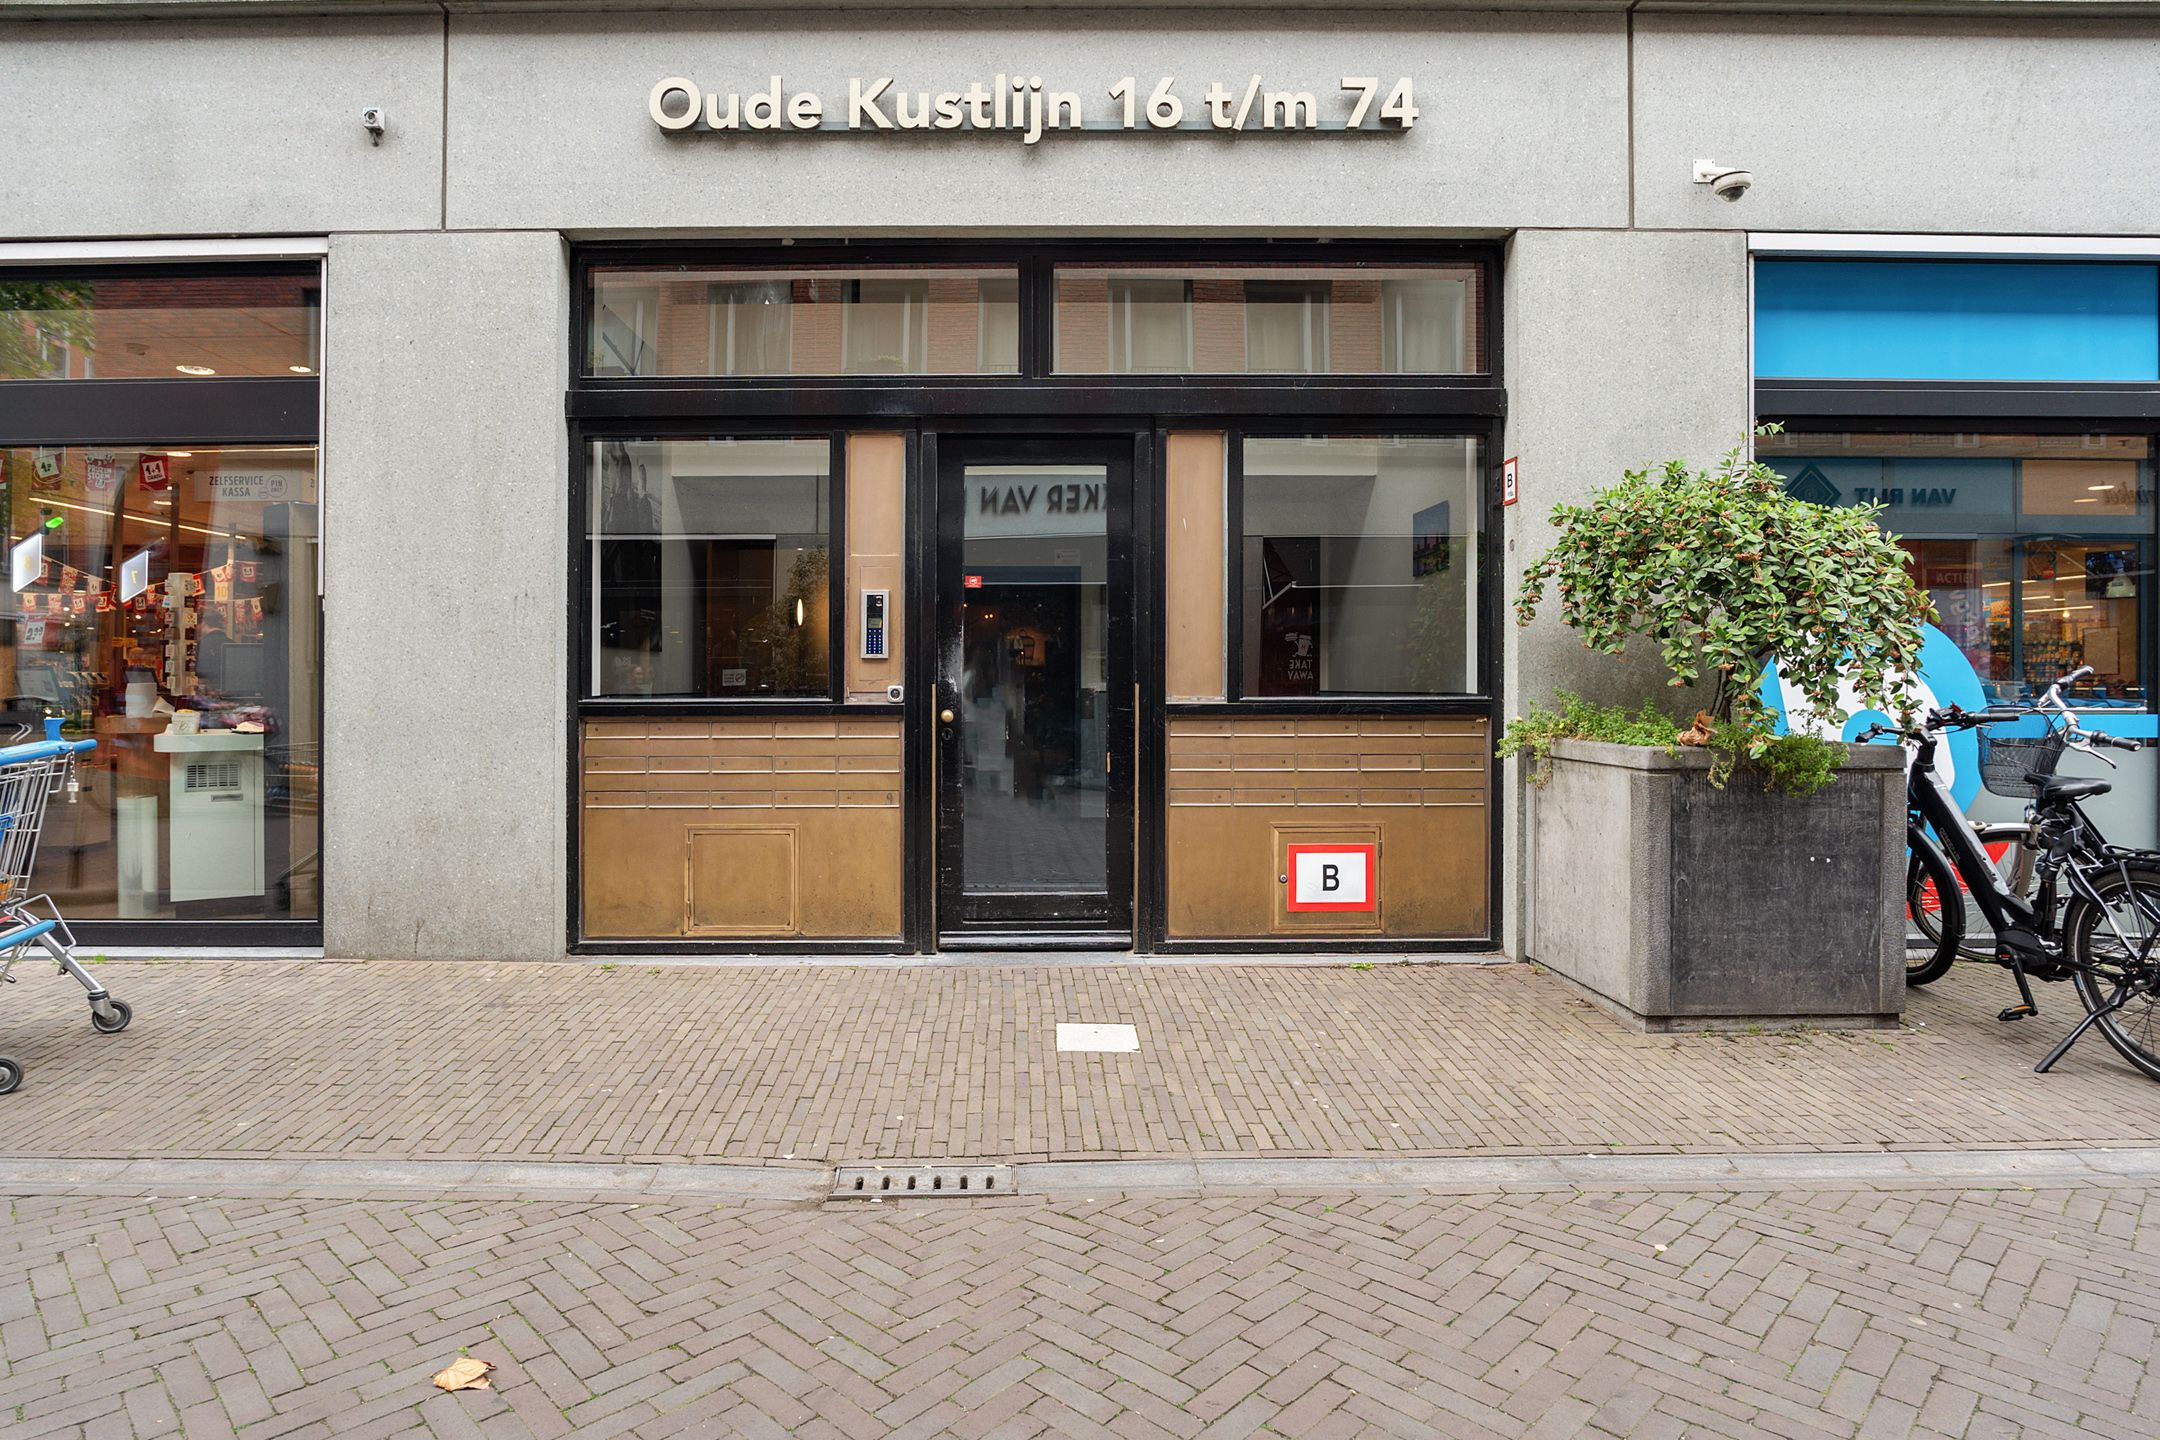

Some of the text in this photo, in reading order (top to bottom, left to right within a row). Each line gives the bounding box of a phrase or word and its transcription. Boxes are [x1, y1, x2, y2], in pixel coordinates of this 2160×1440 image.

[649, 73, 1419, 145] Oude Kustlijn 16 t/m 74
[209, 475, 264, 486] ZELFSERVICE
[1507, 473, 1513, 488] B
[222, 487, 250, 497] KASSA
[1322, 864, 1340, 891] B
